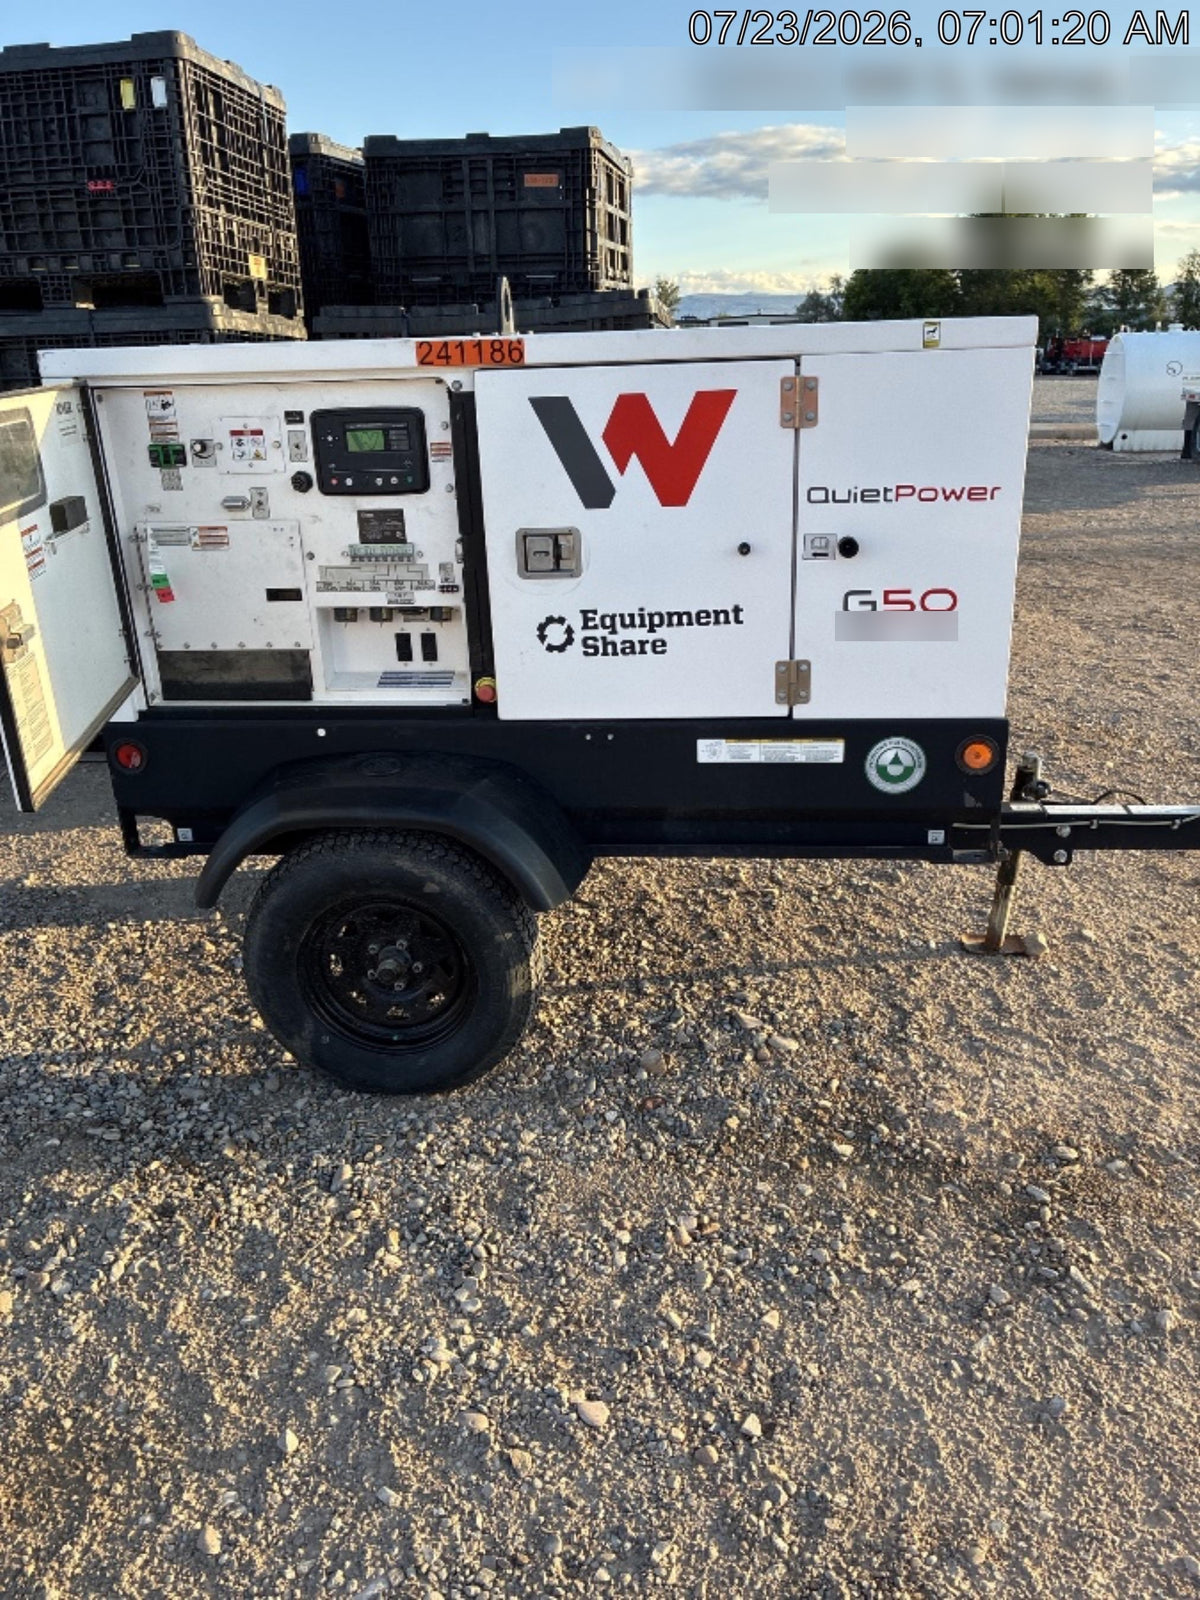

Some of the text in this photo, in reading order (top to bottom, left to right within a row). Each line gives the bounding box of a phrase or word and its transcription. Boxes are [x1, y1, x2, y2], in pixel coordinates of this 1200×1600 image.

[418, 339, 524, 364] 241186
[807, 484, 1002, 504] QuietPower
[843, 588, 958, 611] G50
[580, 604, 744, 634] Equipment
[581, 636, 668, 657] Share
